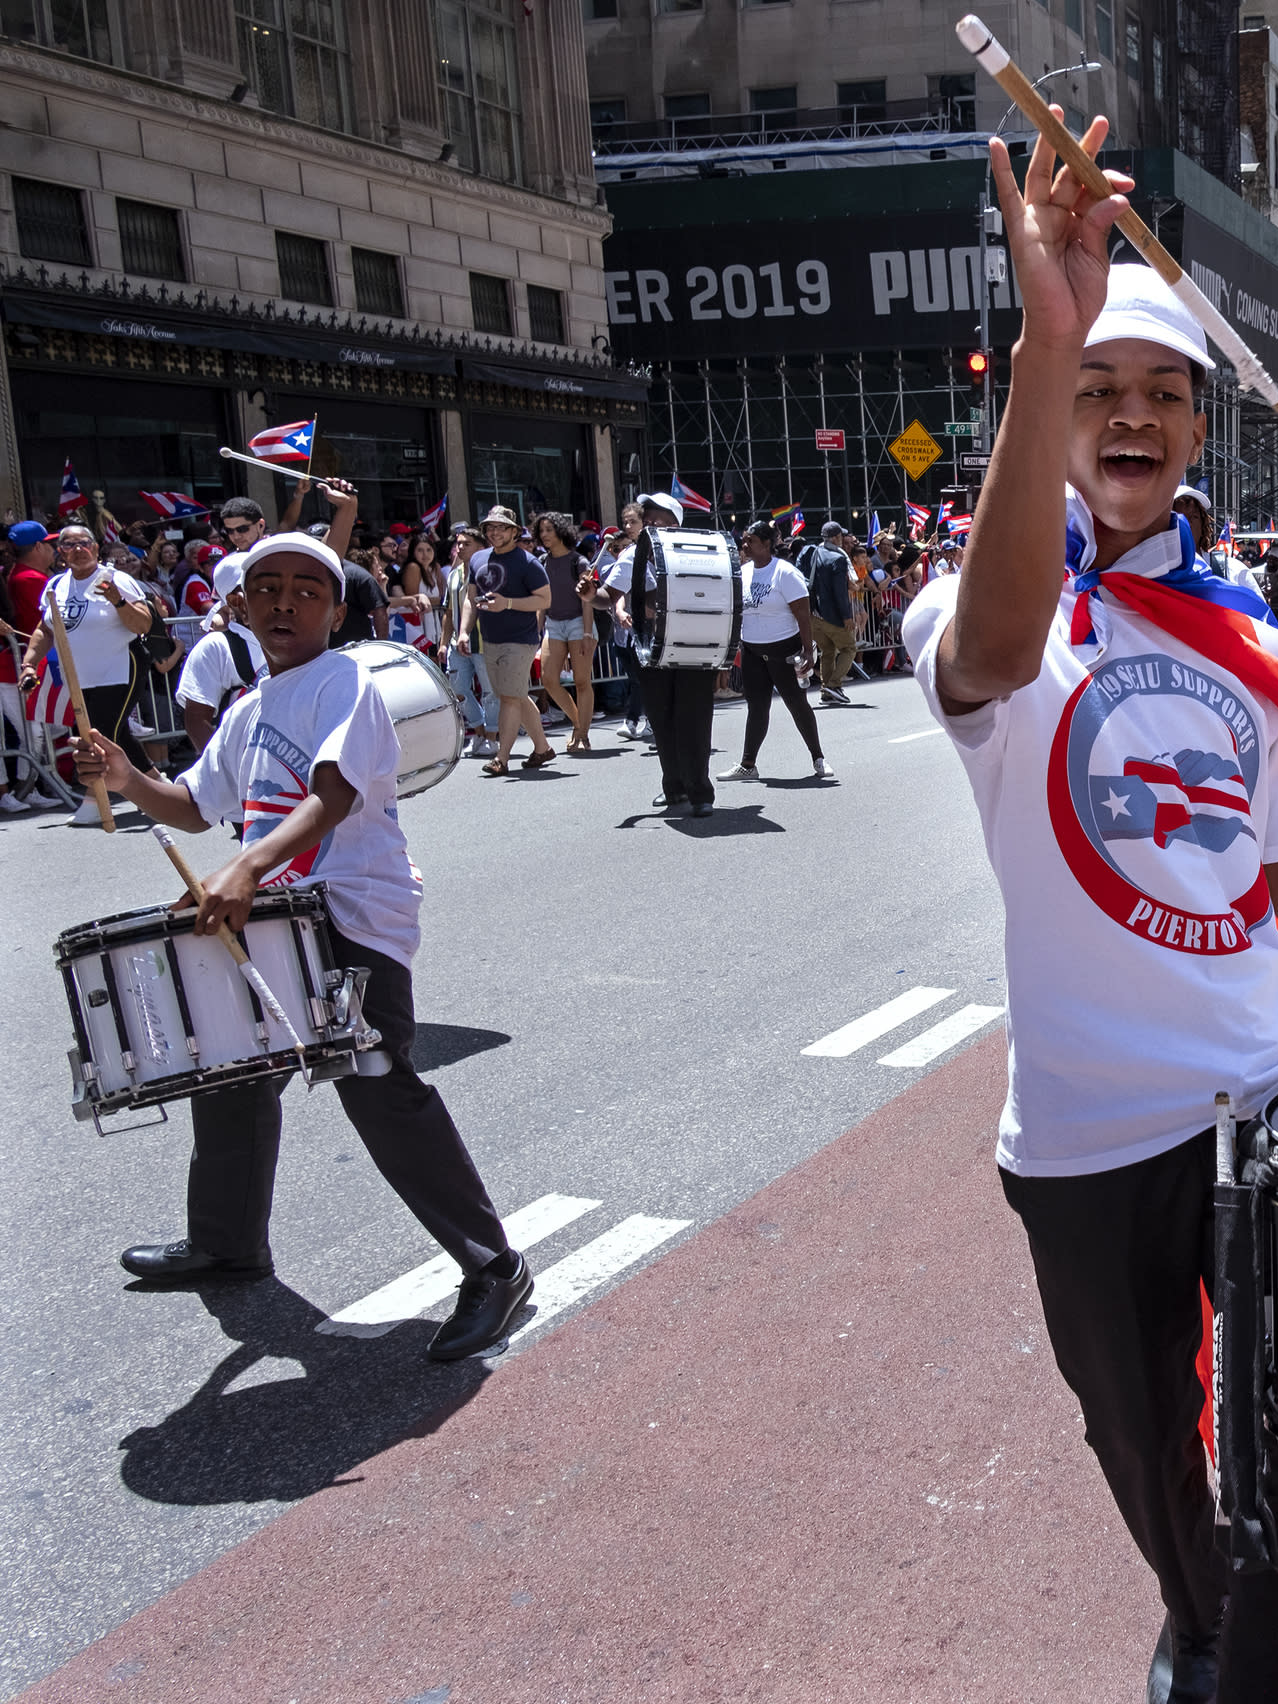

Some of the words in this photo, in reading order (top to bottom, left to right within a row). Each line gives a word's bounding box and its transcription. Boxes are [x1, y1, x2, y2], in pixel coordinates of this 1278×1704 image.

[685, 260, 831, 321] 2019
[869, 245, 1023, 316] PUM
[1236, 289, 1269, 335] COMING
[898, 447, 935, 455] CROSSWALK
[900, 438, 932, 446] RECESSED
[945, 425, 951, 434] E
[954, 424, 966, 434] 49
[1170, 664, 1256, 754] SUPPORTS
[1126, 898, 1238, 950] PUERTO
